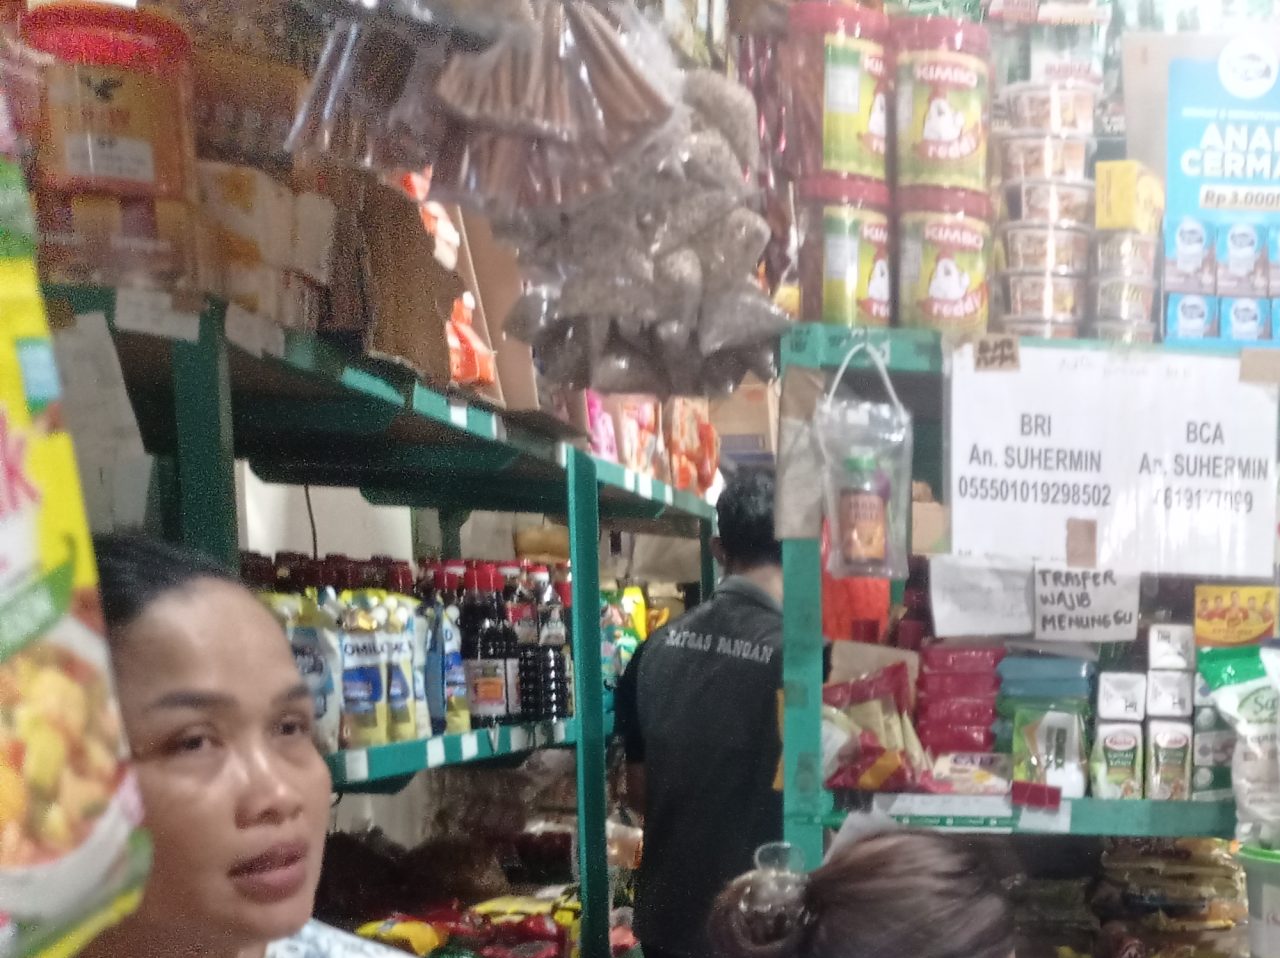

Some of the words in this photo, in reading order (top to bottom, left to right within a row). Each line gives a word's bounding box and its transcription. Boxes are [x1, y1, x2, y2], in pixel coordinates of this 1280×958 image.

[915, 63, 977, 88] KIMBO
[926, 227, 983, 250] KIMBO
[1020, 413, 1052, 437] BRI
[1186, 421, 1224, 445] BCA
[969, 443, 998, 468] An.
[1004, 445, 1102, 474] SUHERMIN
[1138, 452, 1167, 477] An.
[1173, 453, 1269, 480] SUHERMIN
[958, 475, 1112, 507] 055501019298502
[1038, 569, 1117, 591] TRASFER
[1040, 591, 1092, 611] WAJIB
[1041, 611, 1133, 632] MENUNGGU
